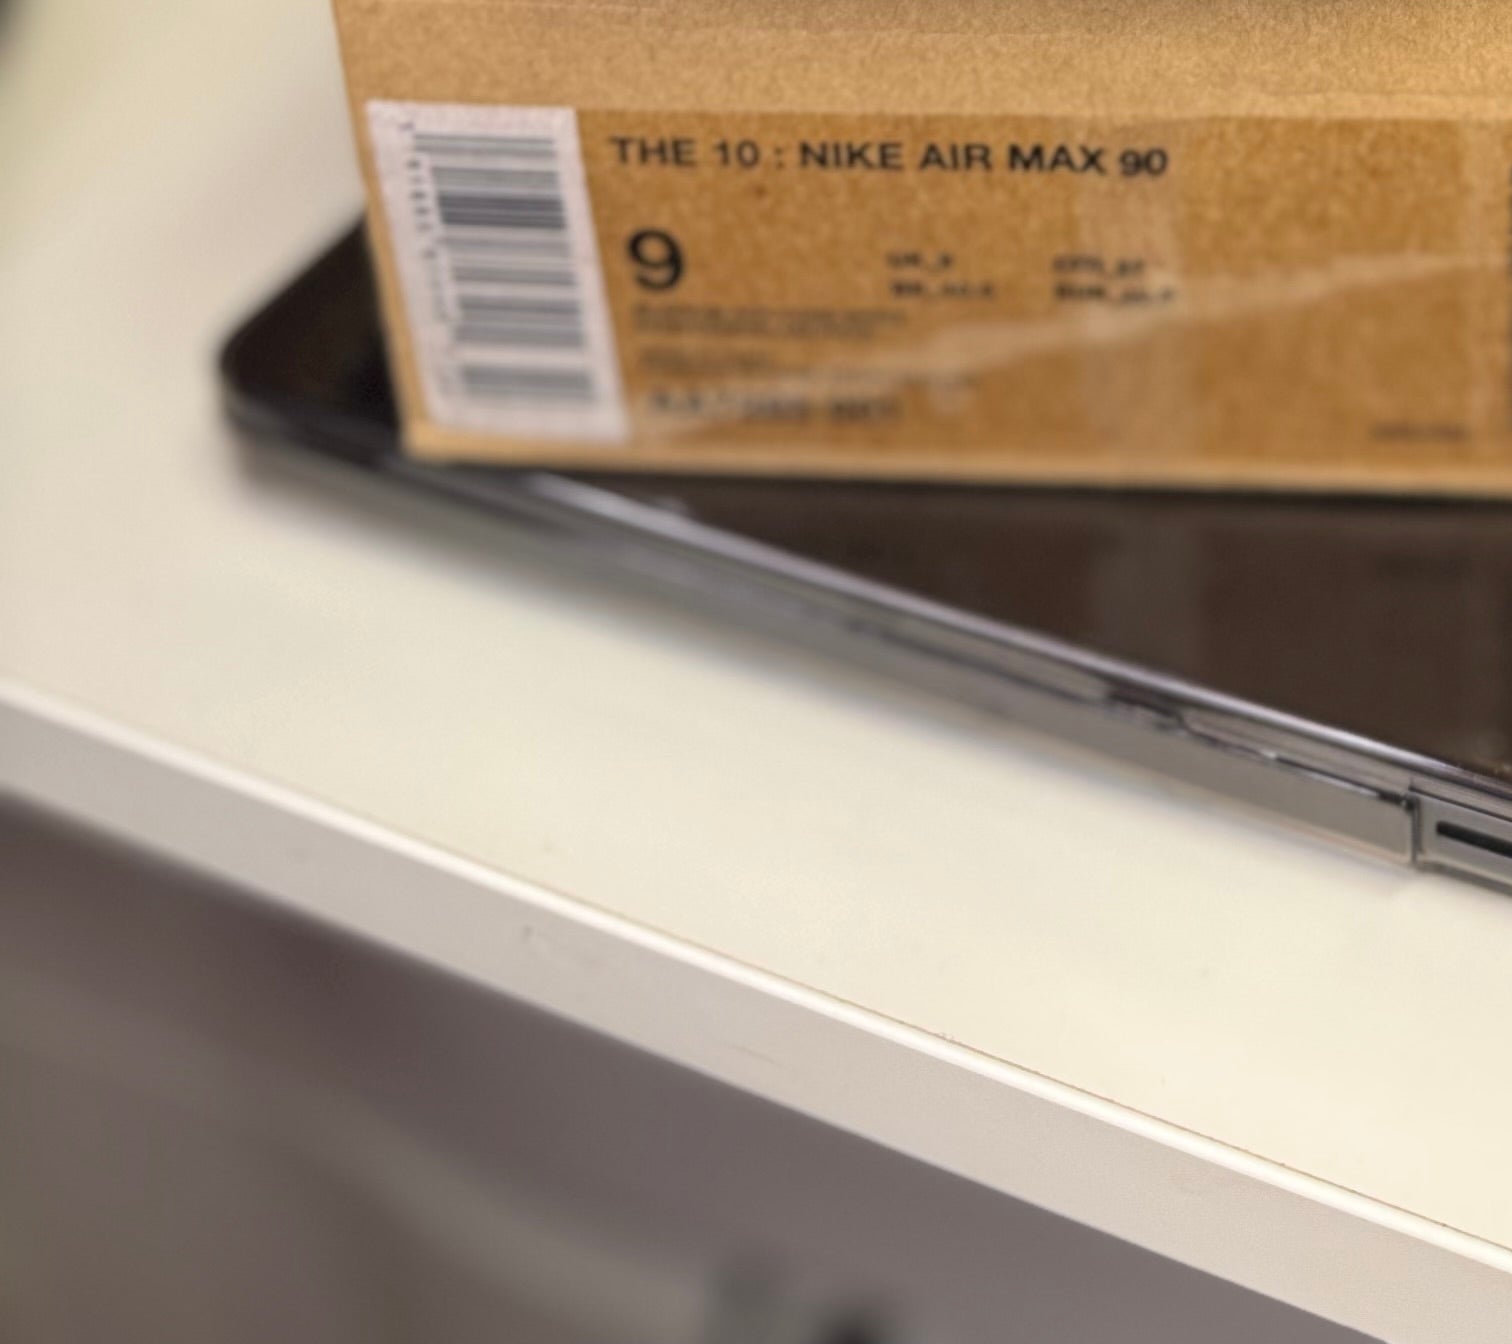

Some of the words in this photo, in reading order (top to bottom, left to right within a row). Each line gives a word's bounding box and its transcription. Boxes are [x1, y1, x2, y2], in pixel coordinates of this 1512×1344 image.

[609, 136, 698, 169] THE
[712, 138, 760, 170] 10
[799, 140, 902, 171] NIKE
[918, 142, 992, 173] AIR
[1007, 143, 1107, 175] MAX
[1119, 147, 1170, 178] 90
[626, 228, 685, 293] 9
